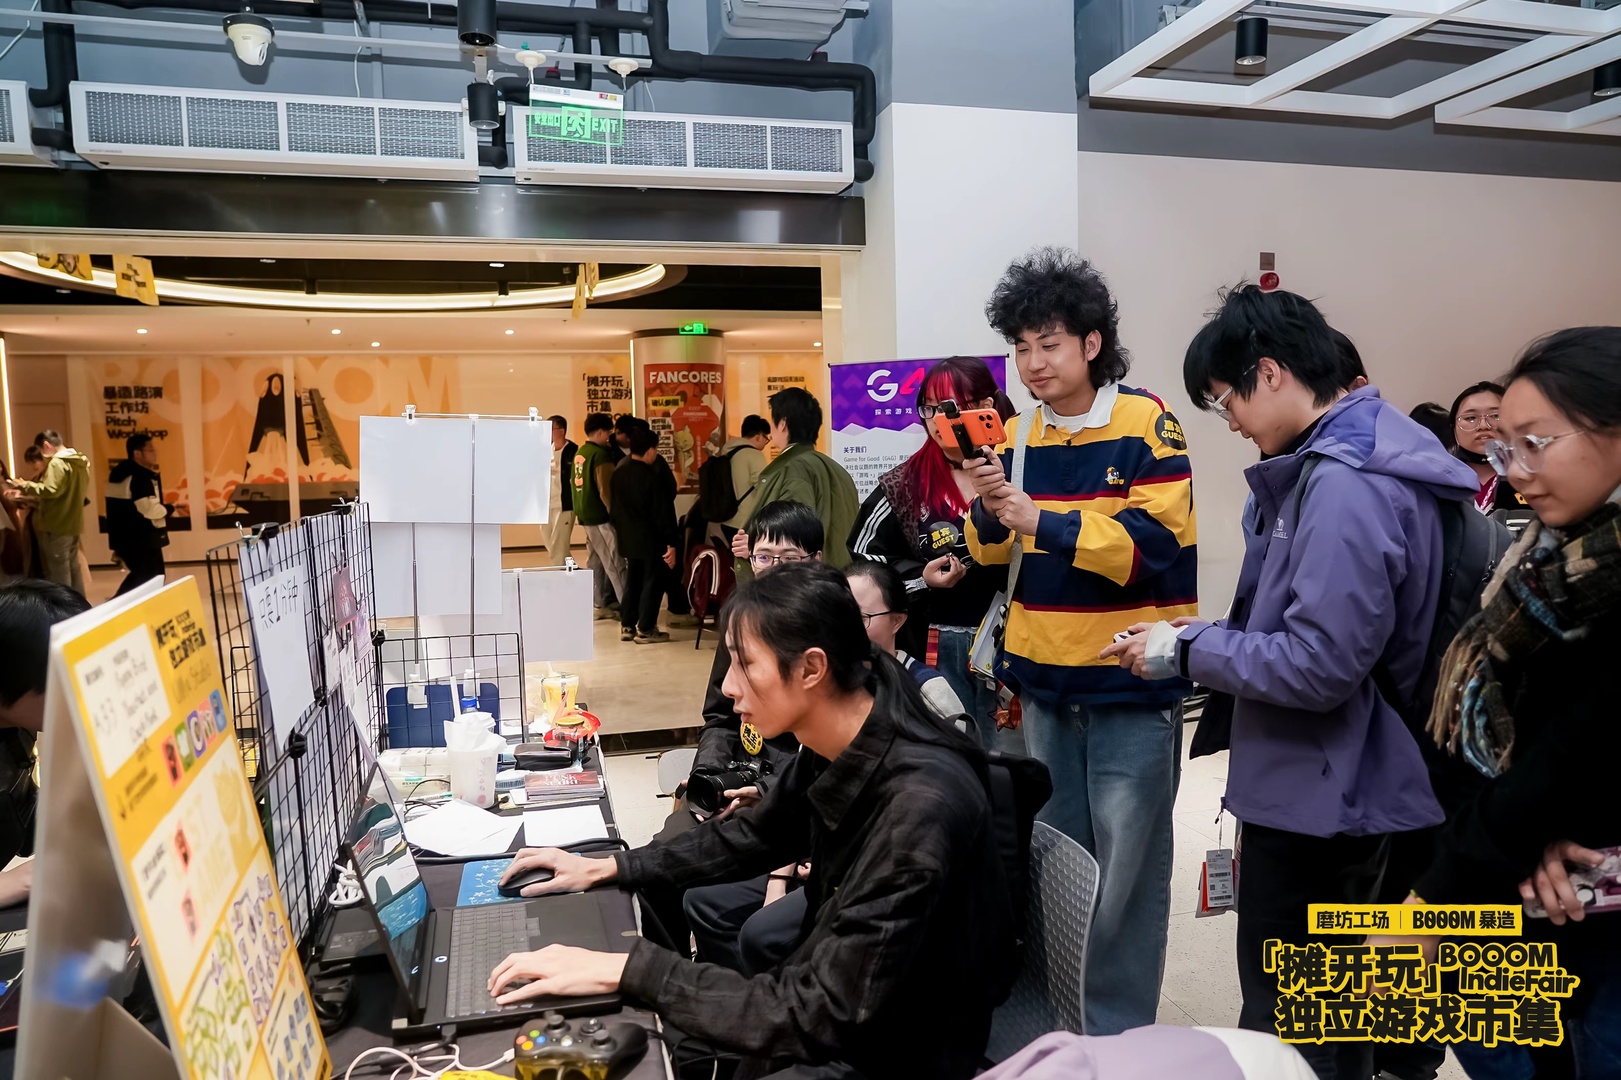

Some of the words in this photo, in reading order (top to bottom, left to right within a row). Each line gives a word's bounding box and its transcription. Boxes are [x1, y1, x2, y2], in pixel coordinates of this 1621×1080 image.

[534, 112, 560, 127] 安全出口
[592, 118, 618, 133] EXIT
[649, 371, 722, 384] FANCORES
[104, 386, 163, 399] 暴造路演
[587, 388, 632, 400] 独立游戏
[105, 401, 149, 414] 工作坊
[586, 400, 612, 412] 市集
[875, 407, 912, 416] 探索游戏
[106, 415, 137, 427] Pitch
[107, 428, 168, 440] Workhop
[1161, 431, 1186, 444] GUEST
[843, 446, 867, 454] 关于我们
[932, 534, 954, 549] GUEST
